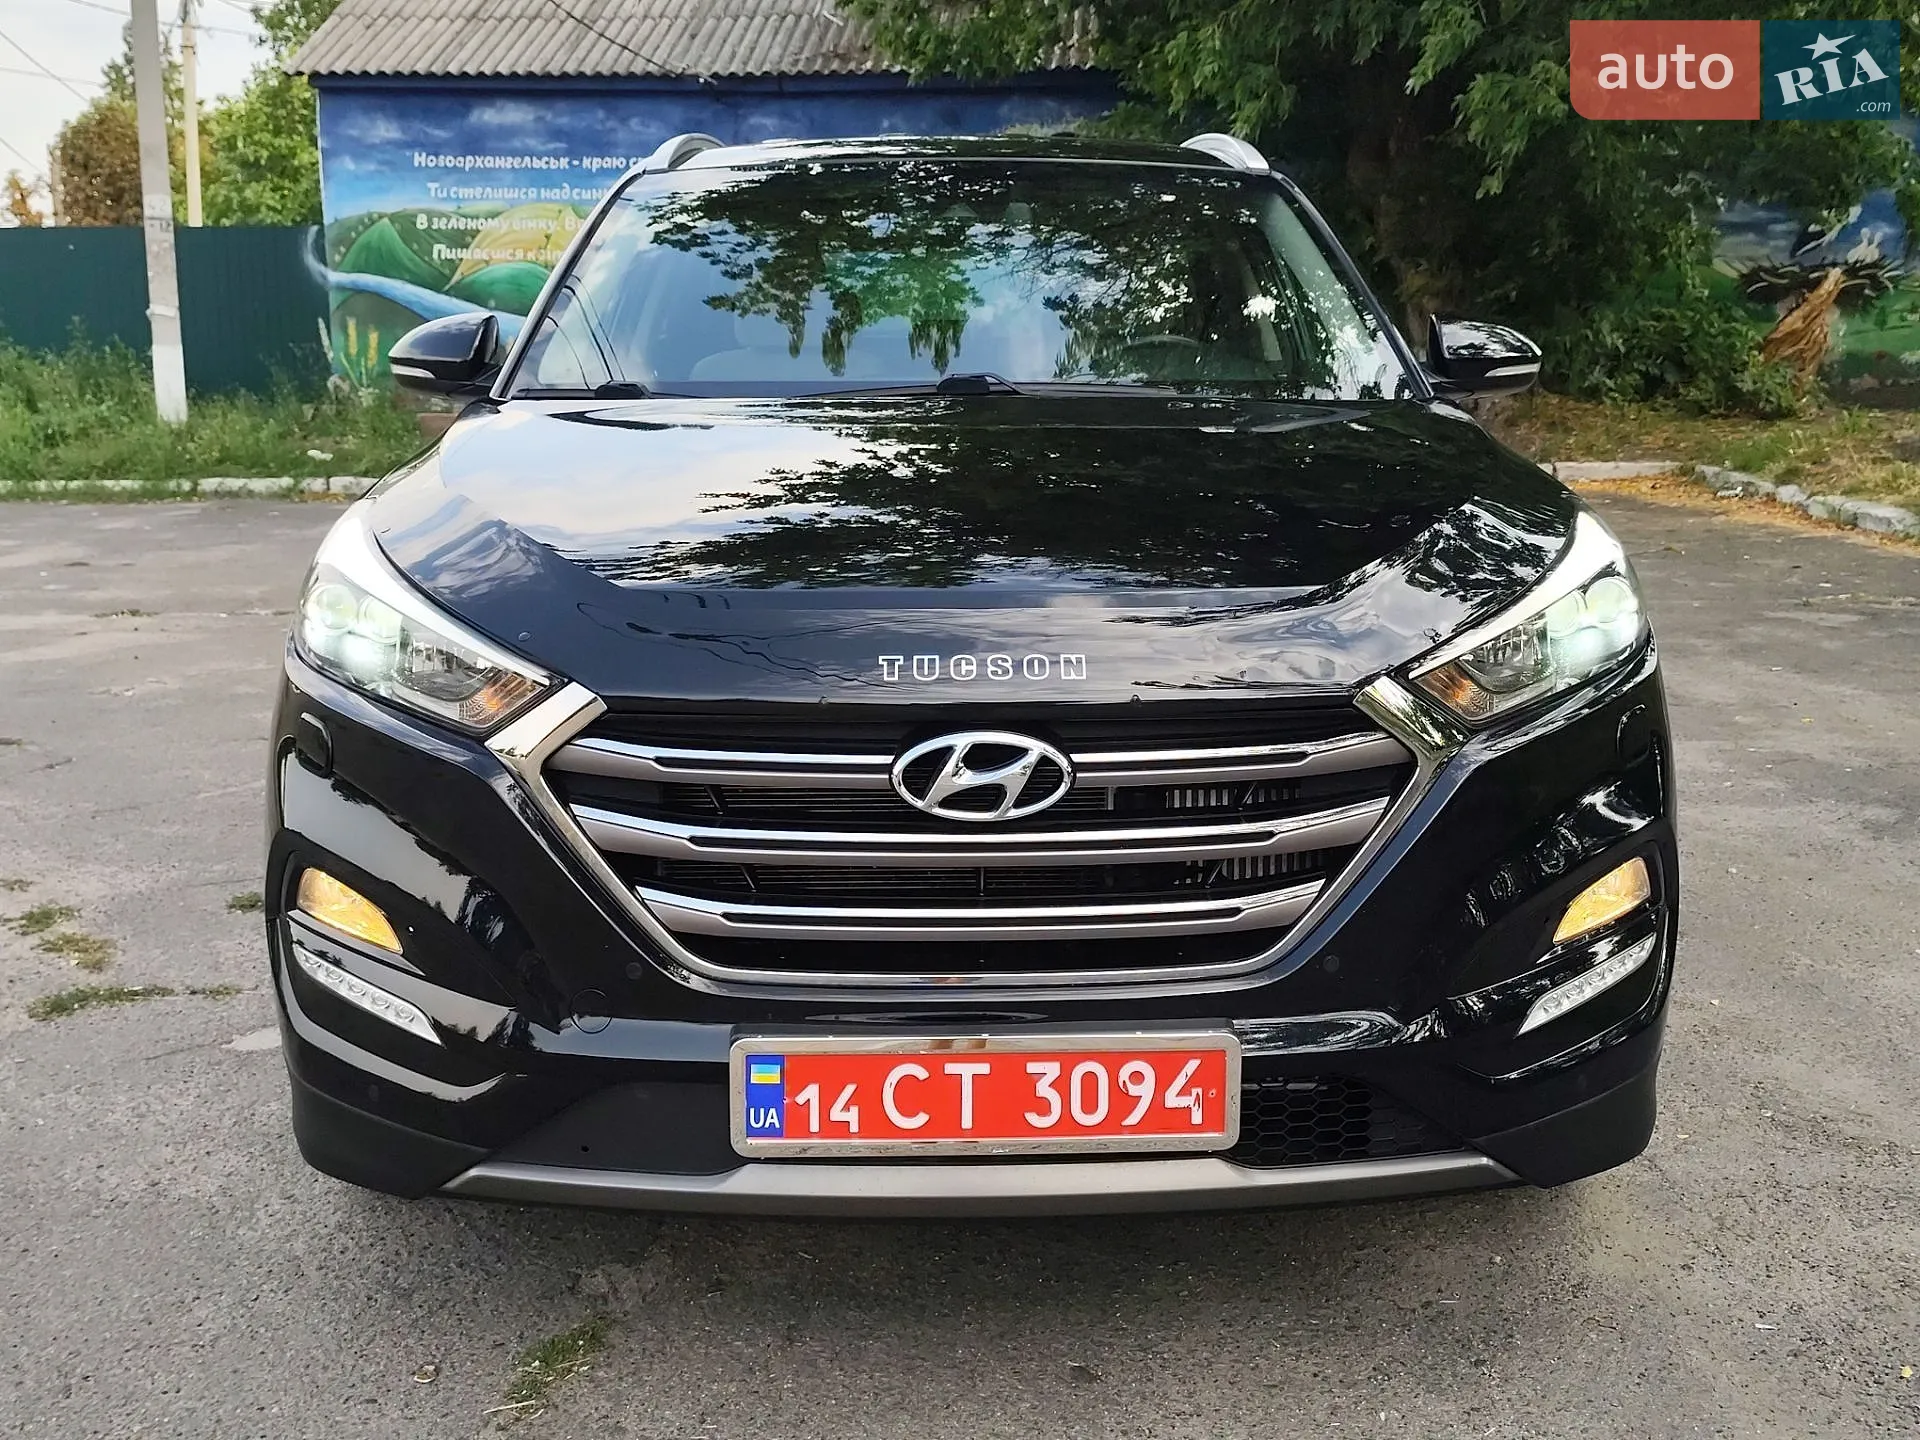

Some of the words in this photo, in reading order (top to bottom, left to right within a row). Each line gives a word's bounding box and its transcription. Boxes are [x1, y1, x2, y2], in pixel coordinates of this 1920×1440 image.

[413, 151, 569, 171] Новоархангельськ
[583, 155, 627, 172] краю
[427, 182, 448, 199] Ти
[450, 186, 536, 200] стелишся
[541, 182, 571, 200] над
[416, 213, 429, 230] В
[431, 217, 510, 234] зеленому
[879, 654, 1087, 681] TUCSON
[748, 1107, 780, 1129] UA
[795, 1083, 859, 1133] 14
[882, 1062, 991, 1130] CT
[1024, 1058, 1204, 1129] 3094
